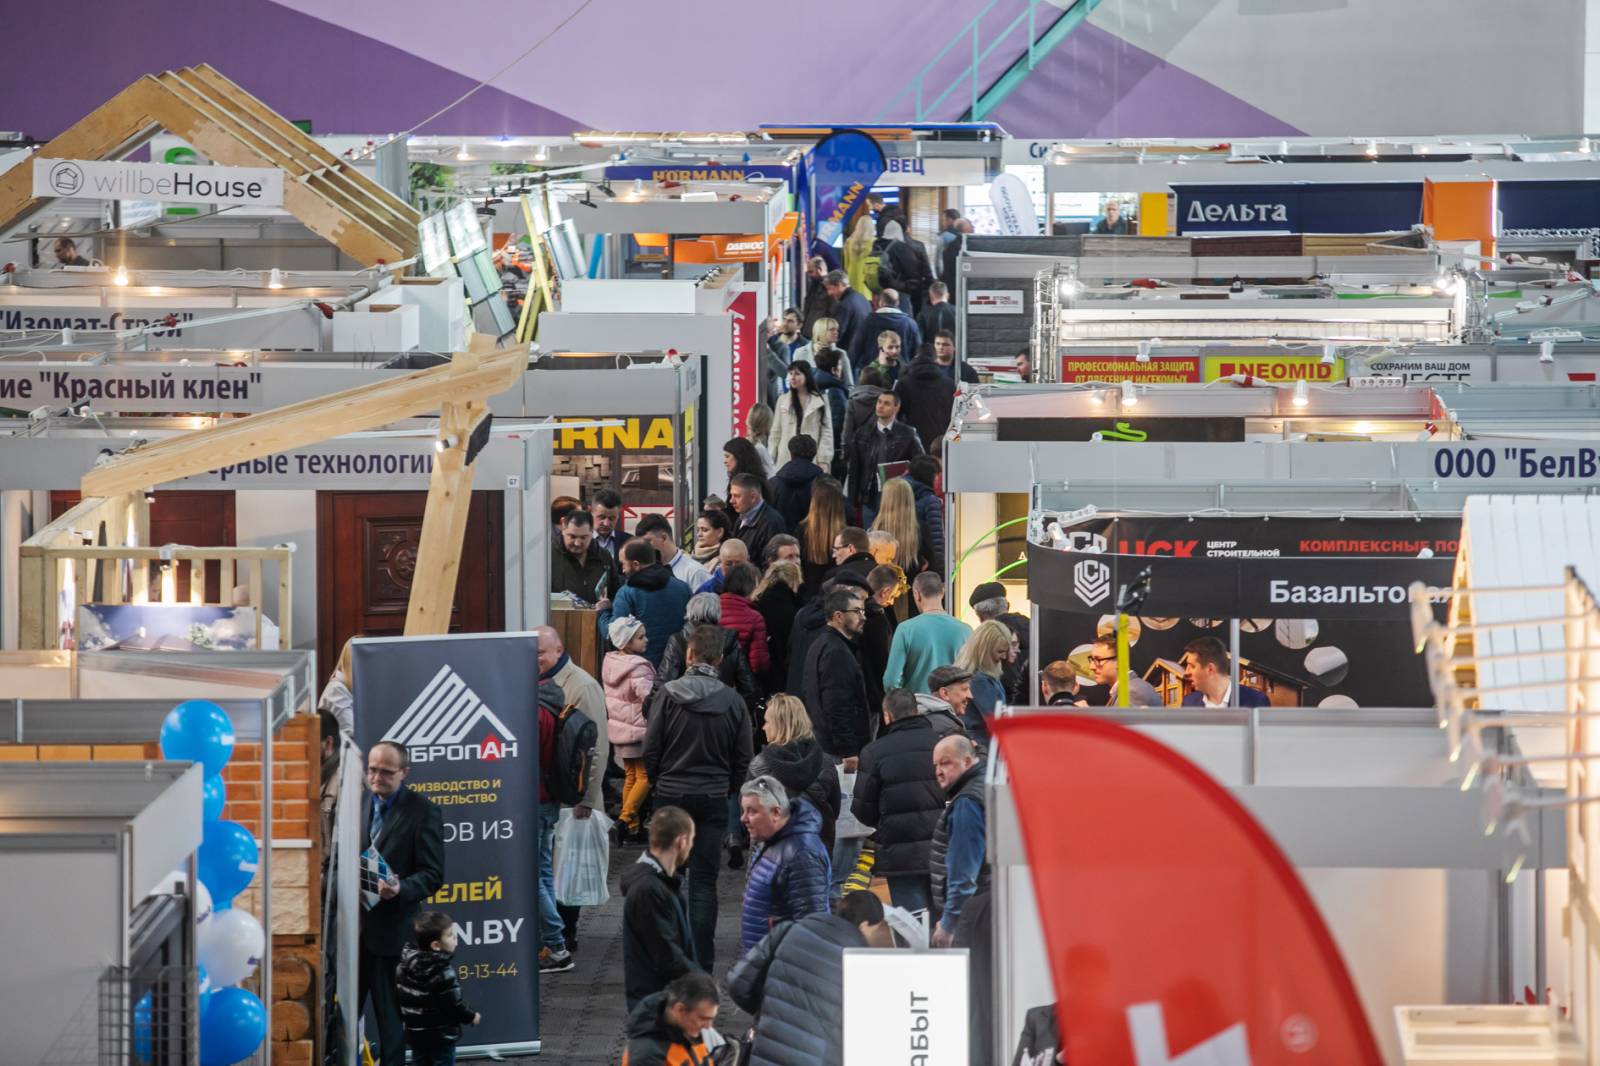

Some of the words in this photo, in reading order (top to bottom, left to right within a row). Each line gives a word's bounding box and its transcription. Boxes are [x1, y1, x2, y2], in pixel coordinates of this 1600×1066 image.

[826, 158, 925, 175] ФАСТВЕЦ
[94, 169, 263, 199] willbeHouse
[1187, 200, 1289, 222] Дельта
[1068, 362, 1158, 372] ПРОФЕССИОНАЛЬНАЯ
[1160, 362, 1195, 373] ЗАЩИТА
[1239, 363, 1332, 379] NEOMID
[1371, 363, 1422, 371] СОХРАНИМ
[1425, 363, 1446, 371] ВАШ
[1448, 363, 1471, 372] ДОМ
[0, 378, 33, 399] ие
[40, 371, 175, 404] "Красный
[183, 371, 261, 400] клен"
[208, 454, 289, 481] рные
[1435, 448, 1496, 478] ООО
[1504, 448, 1600, 478] "БелВ
[1206, 549, 1280, 557] СТРОИТЕЛЬНОЙ
[1207, 541, 1238, 549] ЦЕНТР
[1300, 540, 1430, 553] КОМПЛЕКСНЫЕ
[407, 742, 518, 763] БРОПАН
[406, 780, 489, 793] ОИЗВОДСТВО
[492, 779, 502, 789] И
[482, 820, 514, 841] ИЗ
[427, 875, 503, 905] ЕЛЕЙ
